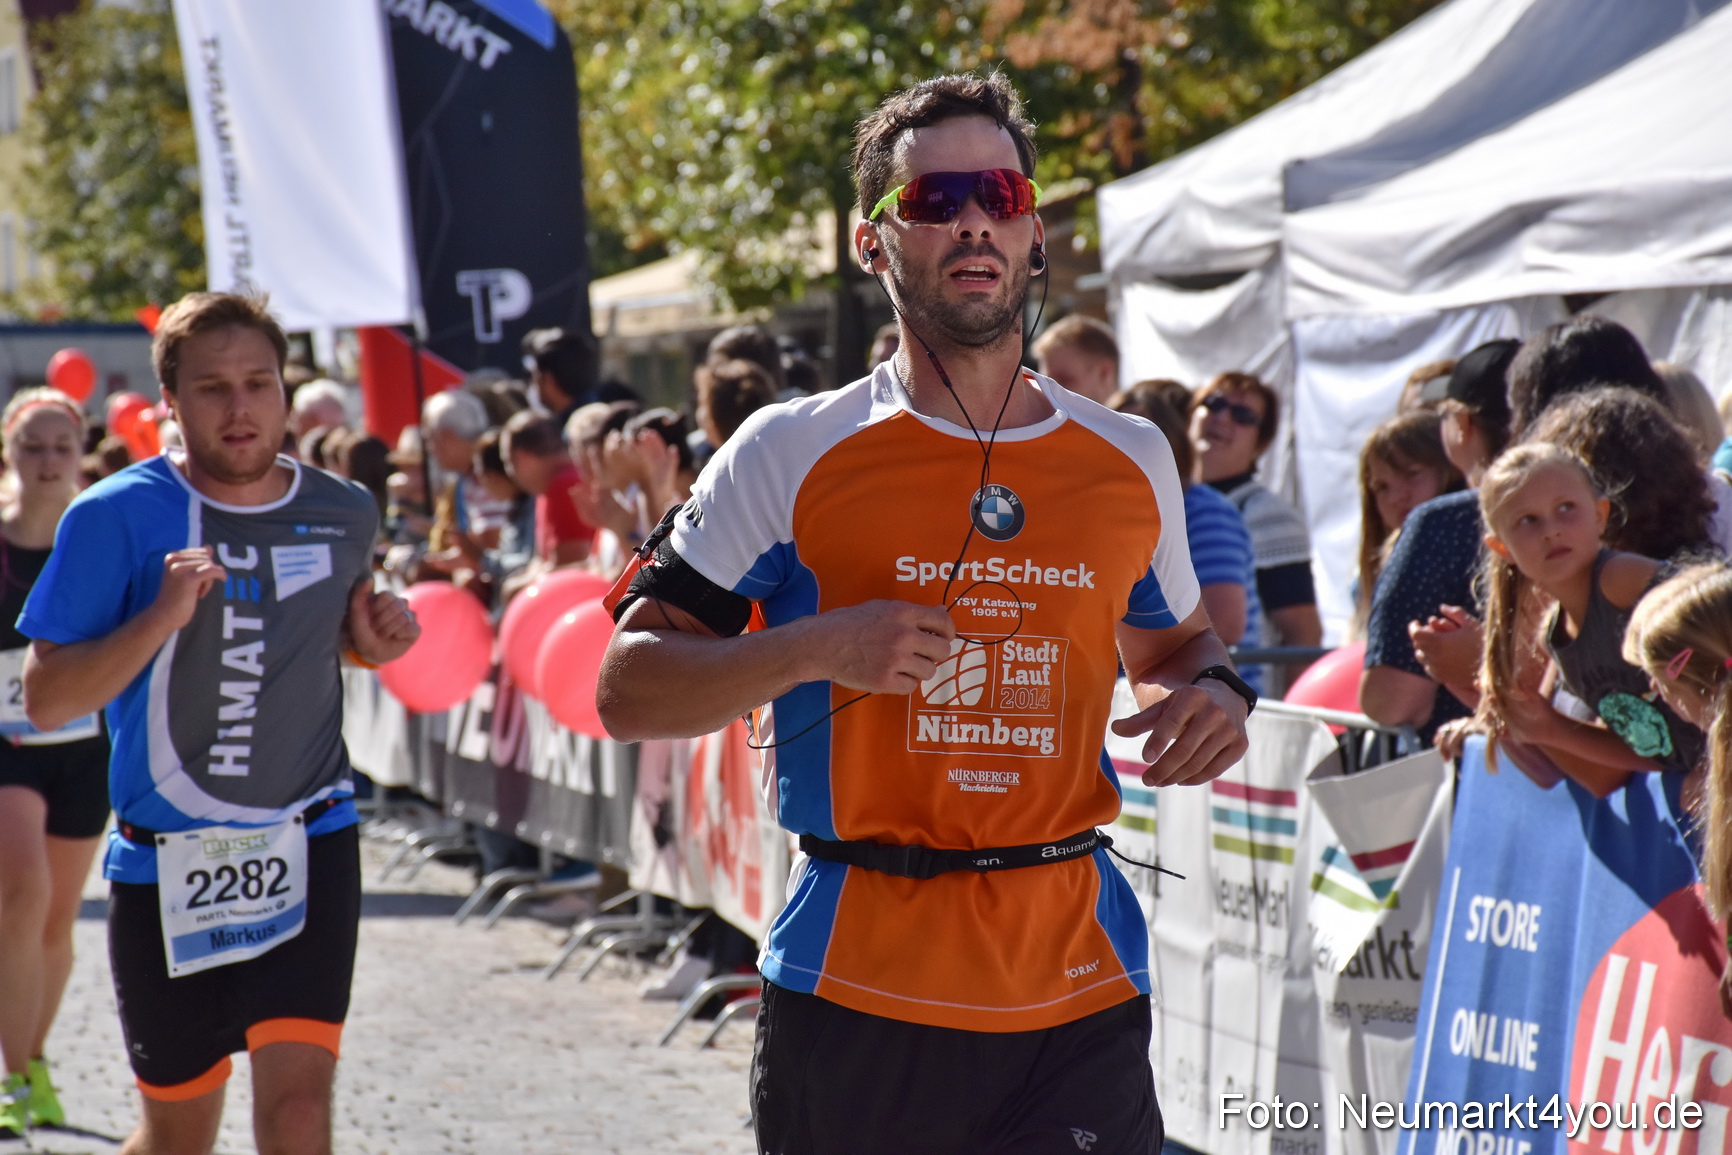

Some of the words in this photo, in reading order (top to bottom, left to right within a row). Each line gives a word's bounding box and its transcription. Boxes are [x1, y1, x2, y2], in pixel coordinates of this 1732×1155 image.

[895, 556, 1096, 589] SportScheck
[971, 607, 998, 616] 1905
[1001, 609, 1019, 618] e.V.
[982, 598, 1037, 611] Katzwang
[207, 542, 264, 777] HIMATEC
[1002, 640, 1059, 663] Stadt
[1002, 663, 1051, 686] Lauf
[1000, 687, 1051, 709] 2014
[916, 715, 1055, 755] Nürnberg
[947, 767, 1020, 784] NÜRNBERGER
[959, 782, 1008, 794] Nachrichten
[1041, 835, 1097, 858] aquama
[186, 857, 291, 911] 2282
[1465, 894, 1542, 953] STORE
[210, 923, 277, 950] Markus
[1449, 1007, 1540, 1072] ONLINE
